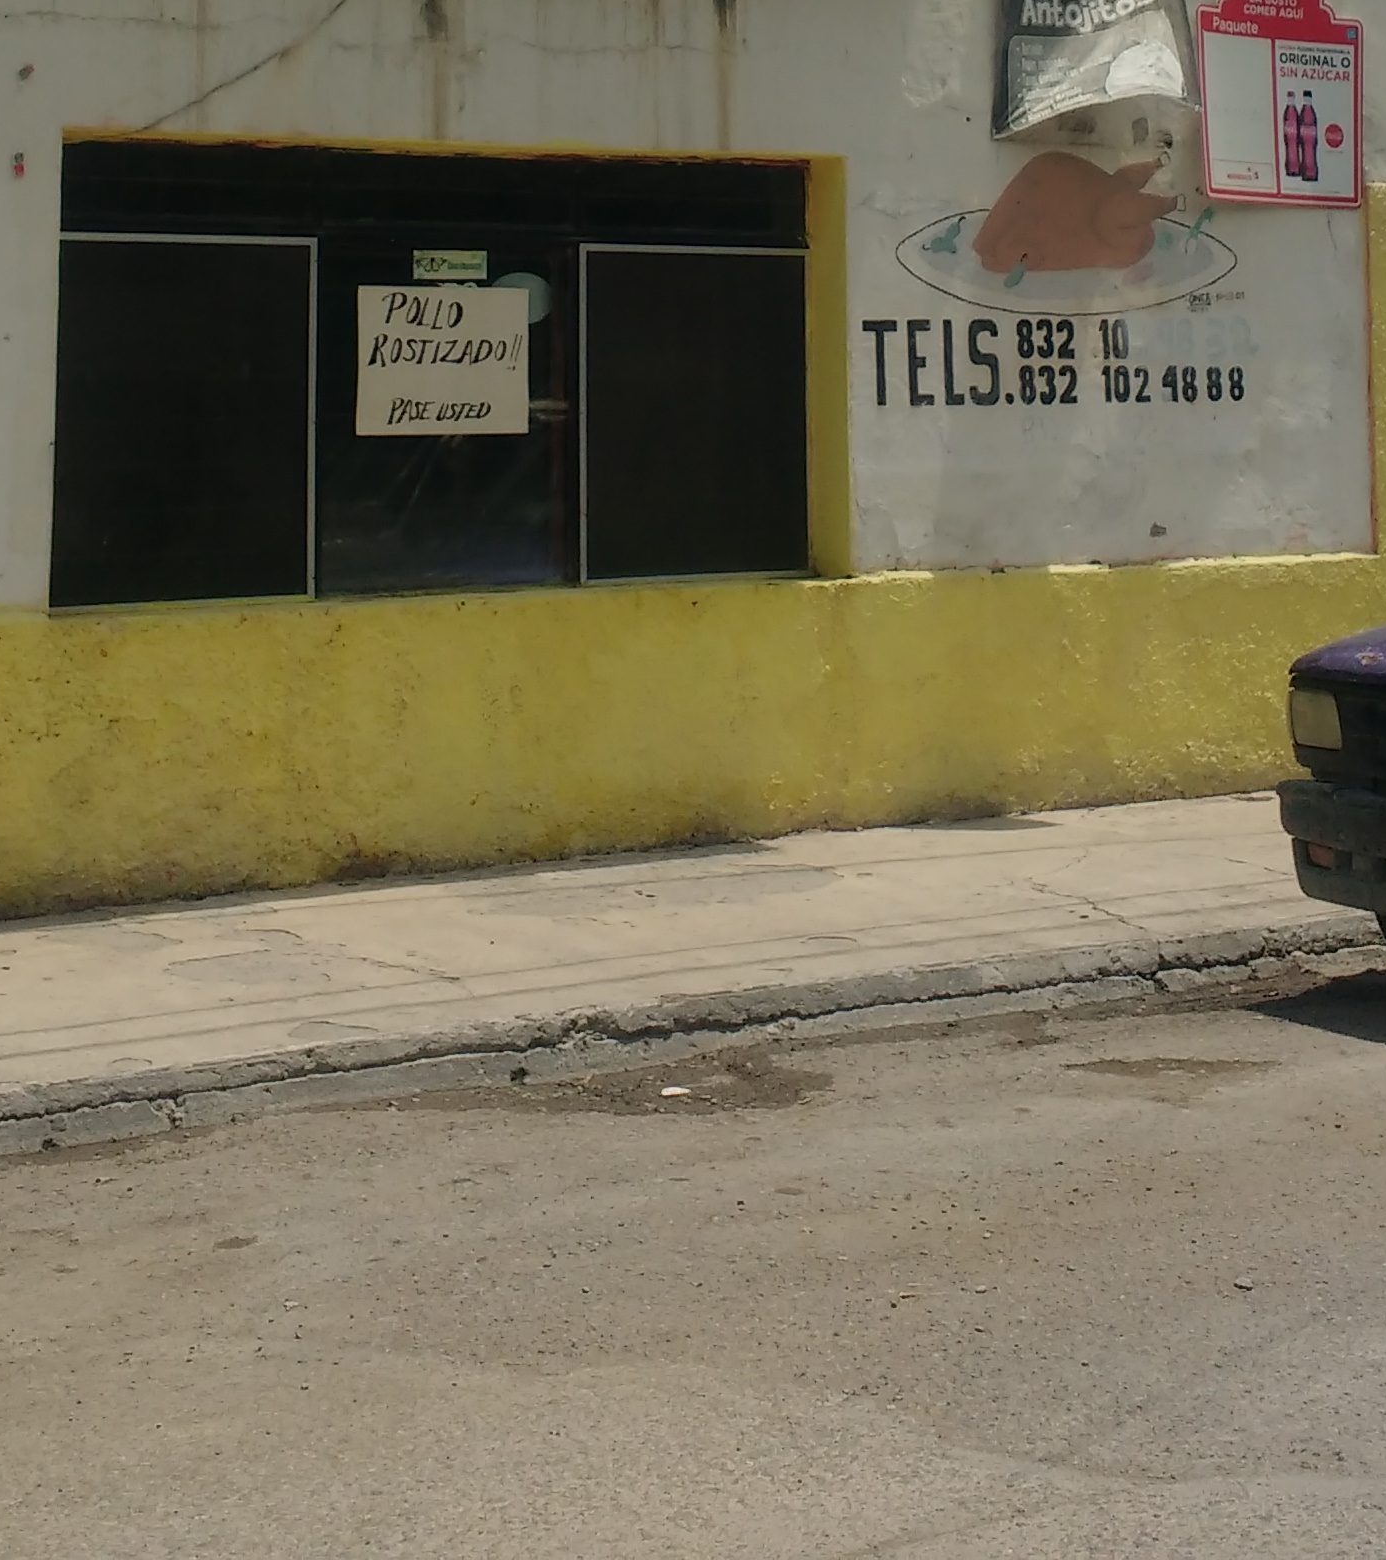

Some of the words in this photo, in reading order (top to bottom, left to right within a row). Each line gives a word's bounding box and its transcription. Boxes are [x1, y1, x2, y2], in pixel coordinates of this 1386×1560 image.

[1243, 3, 1277, 17] COMER
[1212, 15, 1259, 34] Paquete
[1279, 52, 1338, 68] ORIGINAL
[1341, 56, 1352, 69] O
[1279, 66, 1299, 78] SIN
[382, 292, 464, 330] POLLO
[862, 318, 1015, 407] TELS.
[1016, 319, 1076, 360] 832
[1018, 364, 1079, 406] 832
[387, 397, 435, 425] PASE
[435, 401, 492, 422] USTED
